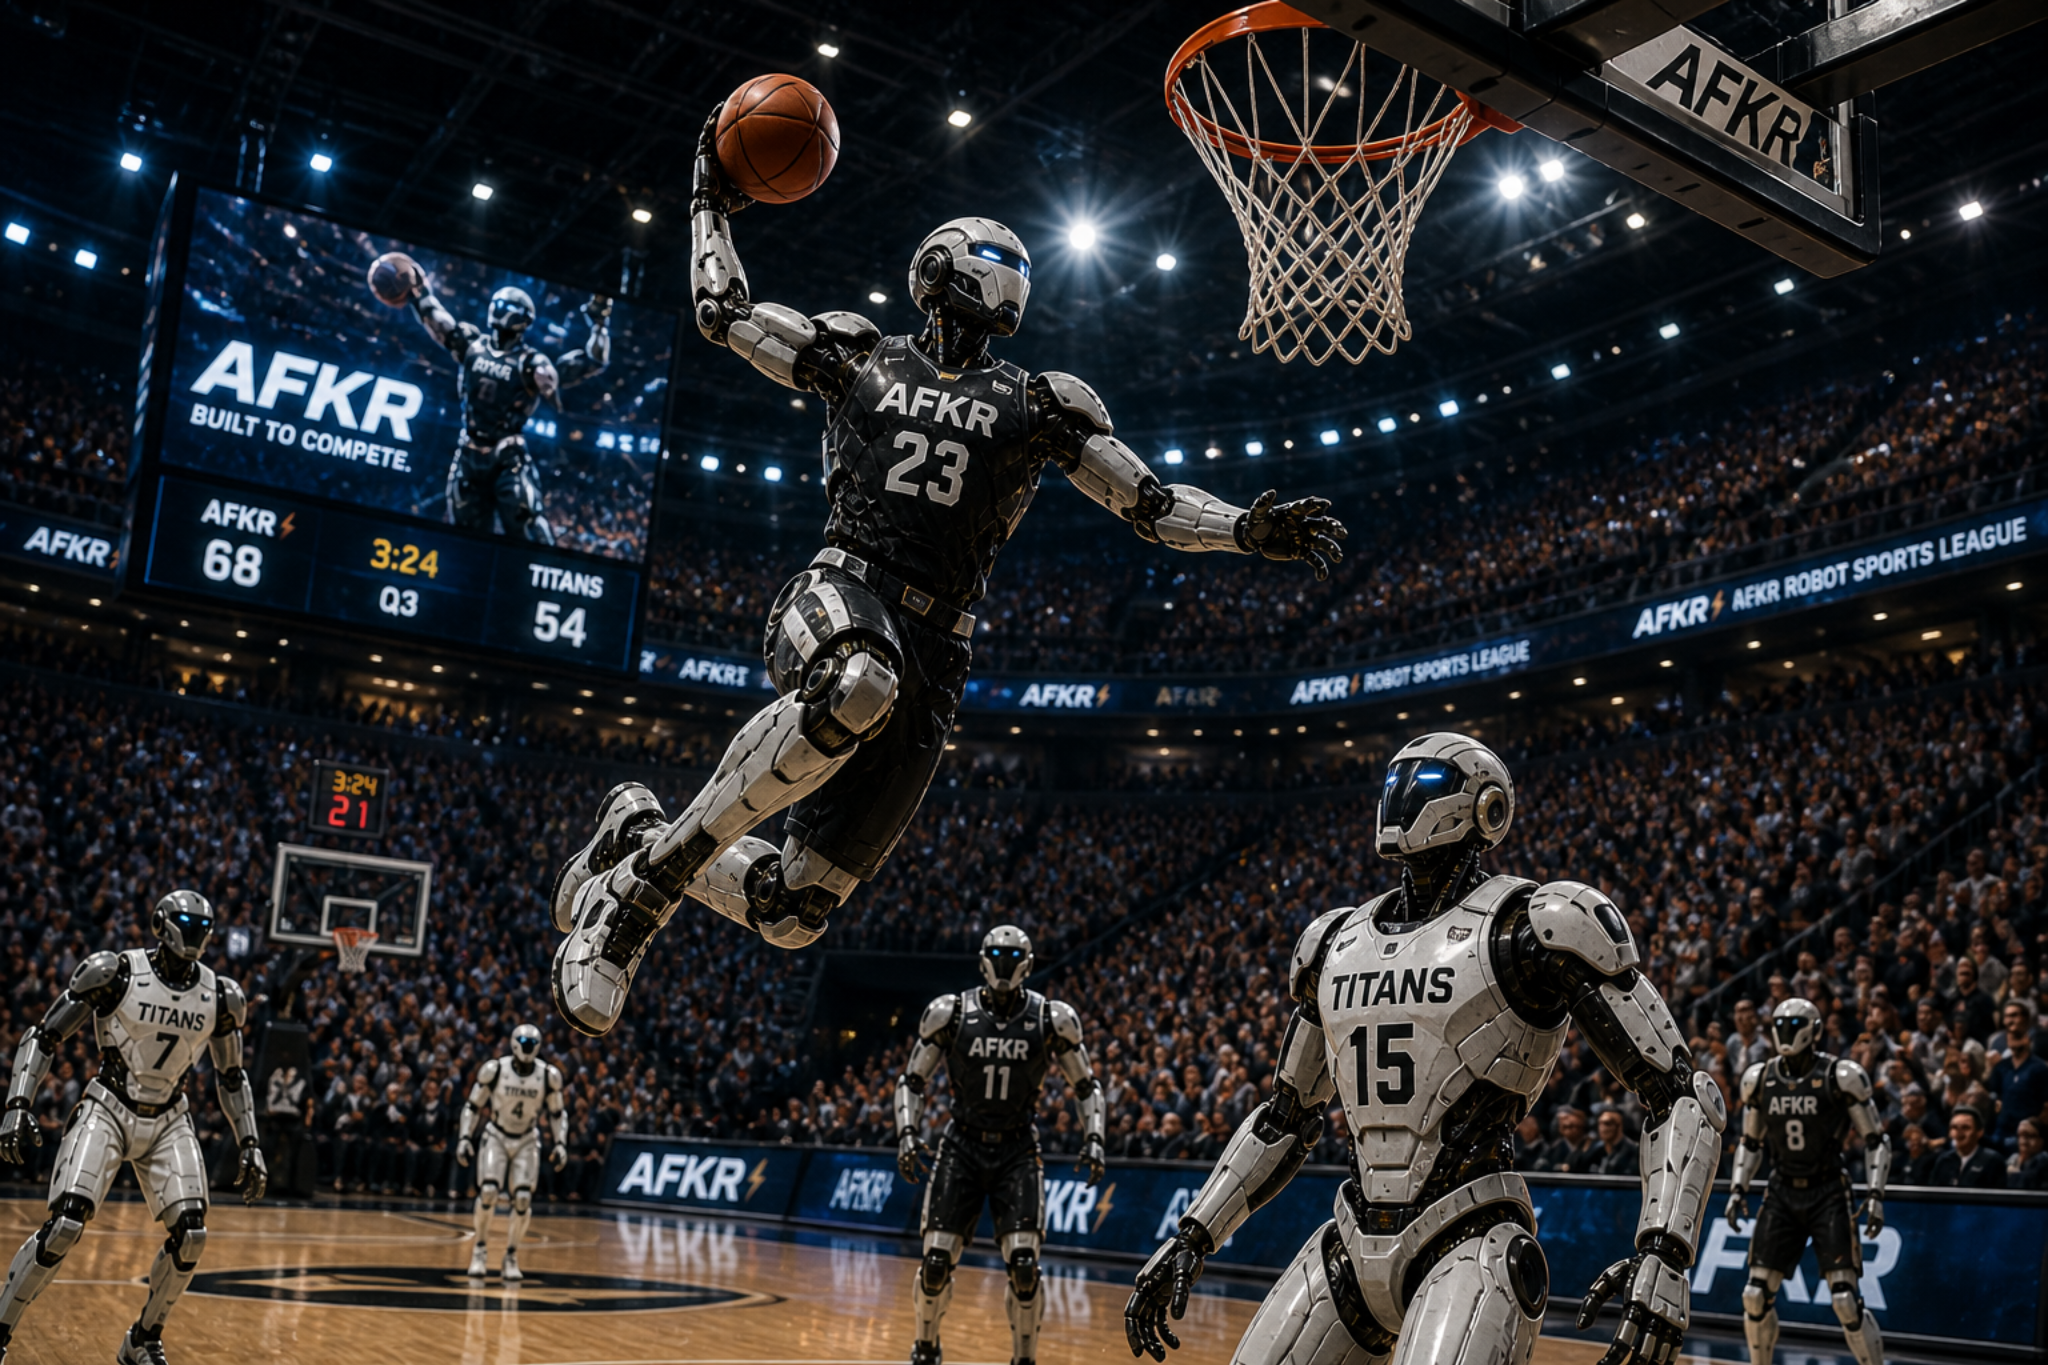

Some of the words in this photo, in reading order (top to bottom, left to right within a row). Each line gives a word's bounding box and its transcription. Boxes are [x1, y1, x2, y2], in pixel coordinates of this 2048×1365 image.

[1645, 43, 1802, 168] AFKR
[190, 339, 424, 442] AFKR
[874, 382, 999, 438] AFKR
[189, 403, 260, 437] BUILT
[265, 419, 297, 446] TO
[301, 429, 412, 473] COMPETE.
[885, 430, 970, 507] 23
[200, 498, 277, 537] AFKR
[23, 526, 111, 568] AFKR
[202, 538, 263, 588] 68
[370, 537, 439, 579] 3:24
[528, 563, 604, 598] TITANS
[1632, 595, 1709, 638] AFKR
[1784, 562, 1849, 598] ROBOT
[1852, 541, 1934, 582] SPORTS
[1939, 516, 2028, 562] LEAGUE
[379, 585, 419, 617] Q3
[533, 600, 587, 648] 54
[1290, 675, 1350, 705] AFKR
[1363, 666, 1411, 693] ROBOT
[1412, 653, 1469, 684] SPORTS
[1471, 640, 1531, 673] LEAGUE
[1019, 683, 1096, 709] AFKR
[332, 770, 378, 797] 3:24
[328, 794, 368, 829] 21
[1331, 967, 1456, 1011] TITANS
[138, 1001, 206, 1032] TITANS
[152, 1031, 180, 1071] 7
[968, 1037, 1029, 1061] AFKR
[1350, 1022, 1416, 1107] 15
[983, 1065, 1011, 1100] 11
[511, 1101, 524, 1119] 4
[1768, 1095, 1818, 1116] AFKR
[1785, 1119, 1806, 1151] 8
[617, 1151, 747, 1202] AFKR
[1044, 1179, 1098, 1234] KR
[1685, 1217, 1902, 1310] FR
